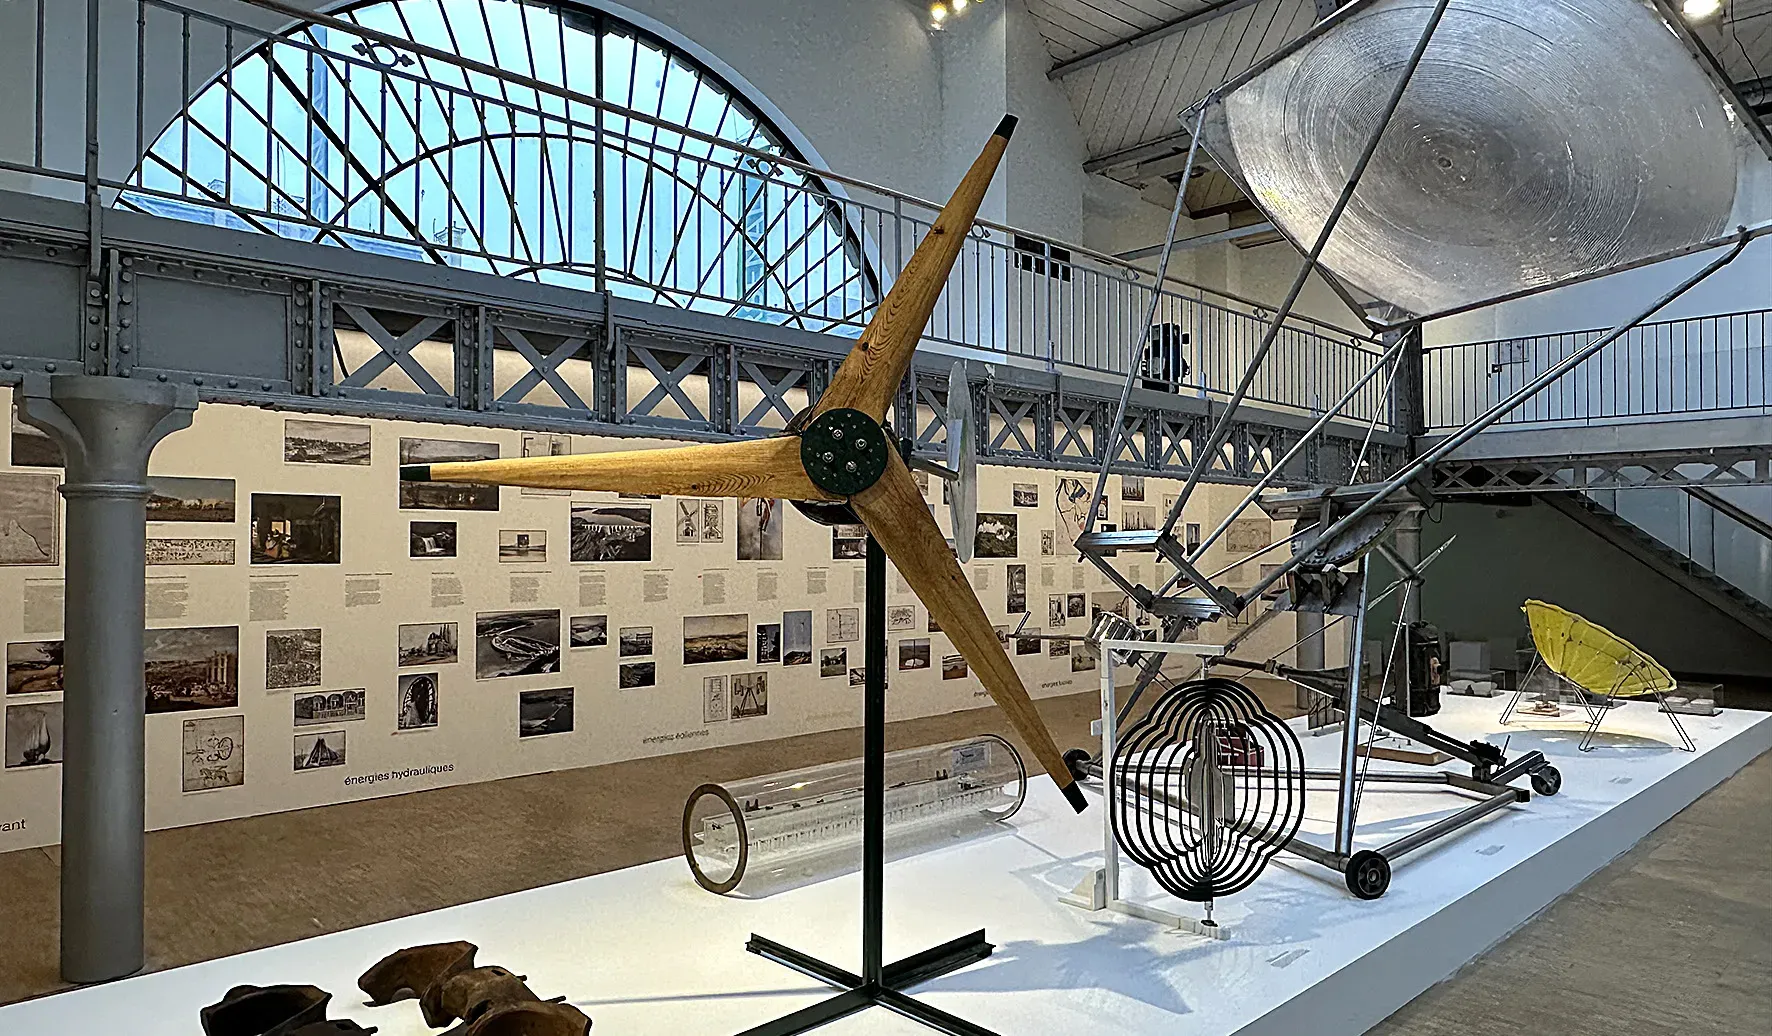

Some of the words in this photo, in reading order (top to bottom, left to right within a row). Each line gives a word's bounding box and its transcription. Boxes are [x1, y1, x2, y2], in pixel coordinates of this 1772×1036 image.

[344, 772, 390, 786] énergies
[391, 763, 455, 780] hydrauliques
[0, 818, 26, 832] ant
